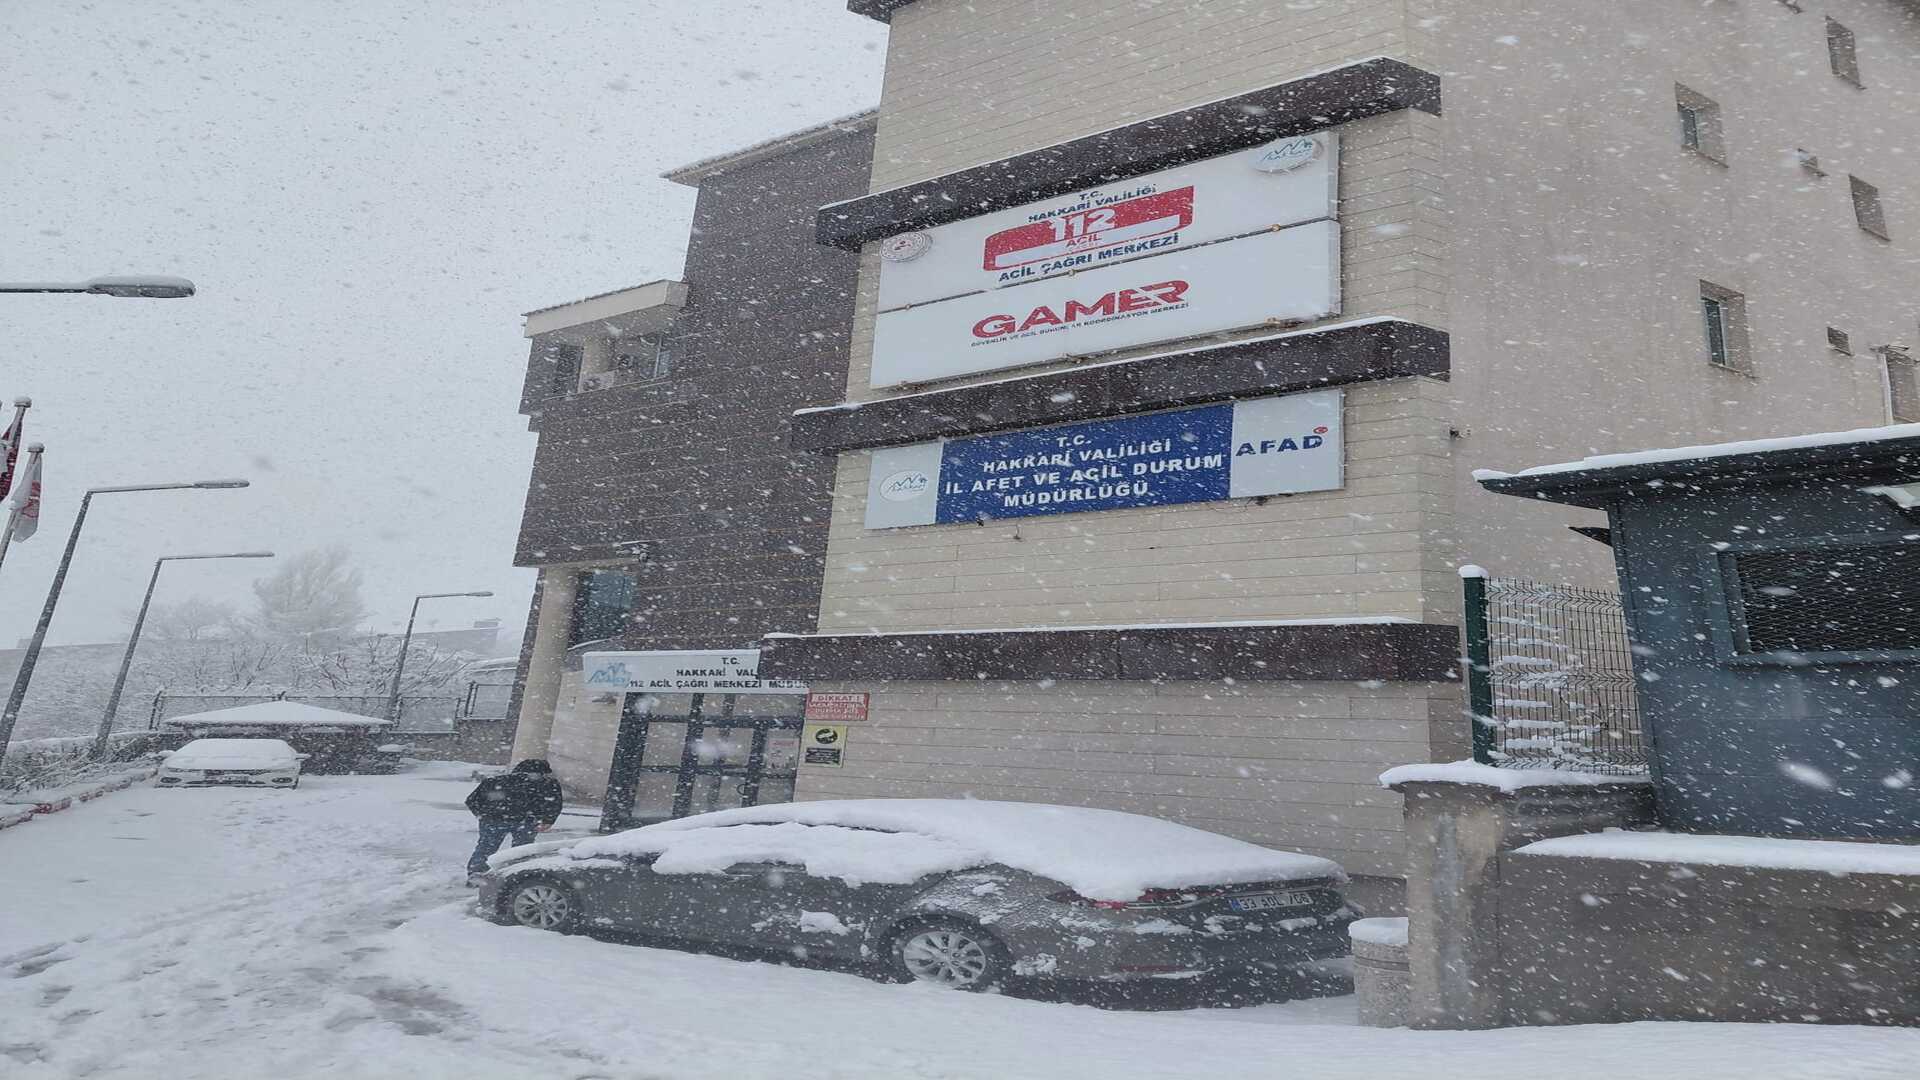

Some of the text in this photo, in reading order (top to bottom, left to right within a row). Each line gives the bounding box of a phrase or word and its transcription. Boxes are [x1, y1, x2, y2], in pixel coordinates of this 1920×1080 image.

[1028, 184, 1157, 222] HAKKARİ VALİLİĞİ
[1079, 190, 1104, 201] T.C.
[1049, 207, 1116, 242] 112
[998, 232, 1179, 282] ACİL ÇAĞRI MERKEZİ
[972, 280, 1190, 339] GAMER
[1056, 434, 1092, 448] T.C.
[1235, 435, 1324, 457] AFAD
[983, 438, 1172, 473] HAKKARİ VALİLİĞİ
[971, 475, 1025, 493] AFET
[1033, 471, 1061, 486] VE
[1133, 453, 1223, 476] DURUM
[1003, 479, 1149, 507] MÜDÜRLÜĞÜ
[675, 667, 726, 677] HAKKARİ
[721, 656, 741, 665] T.C.
[649, 678, 673, 688] ACİL
[676, 679, 709, 690] ÇAĞRI
[713, 679, 762, 688] MERKEZİ
